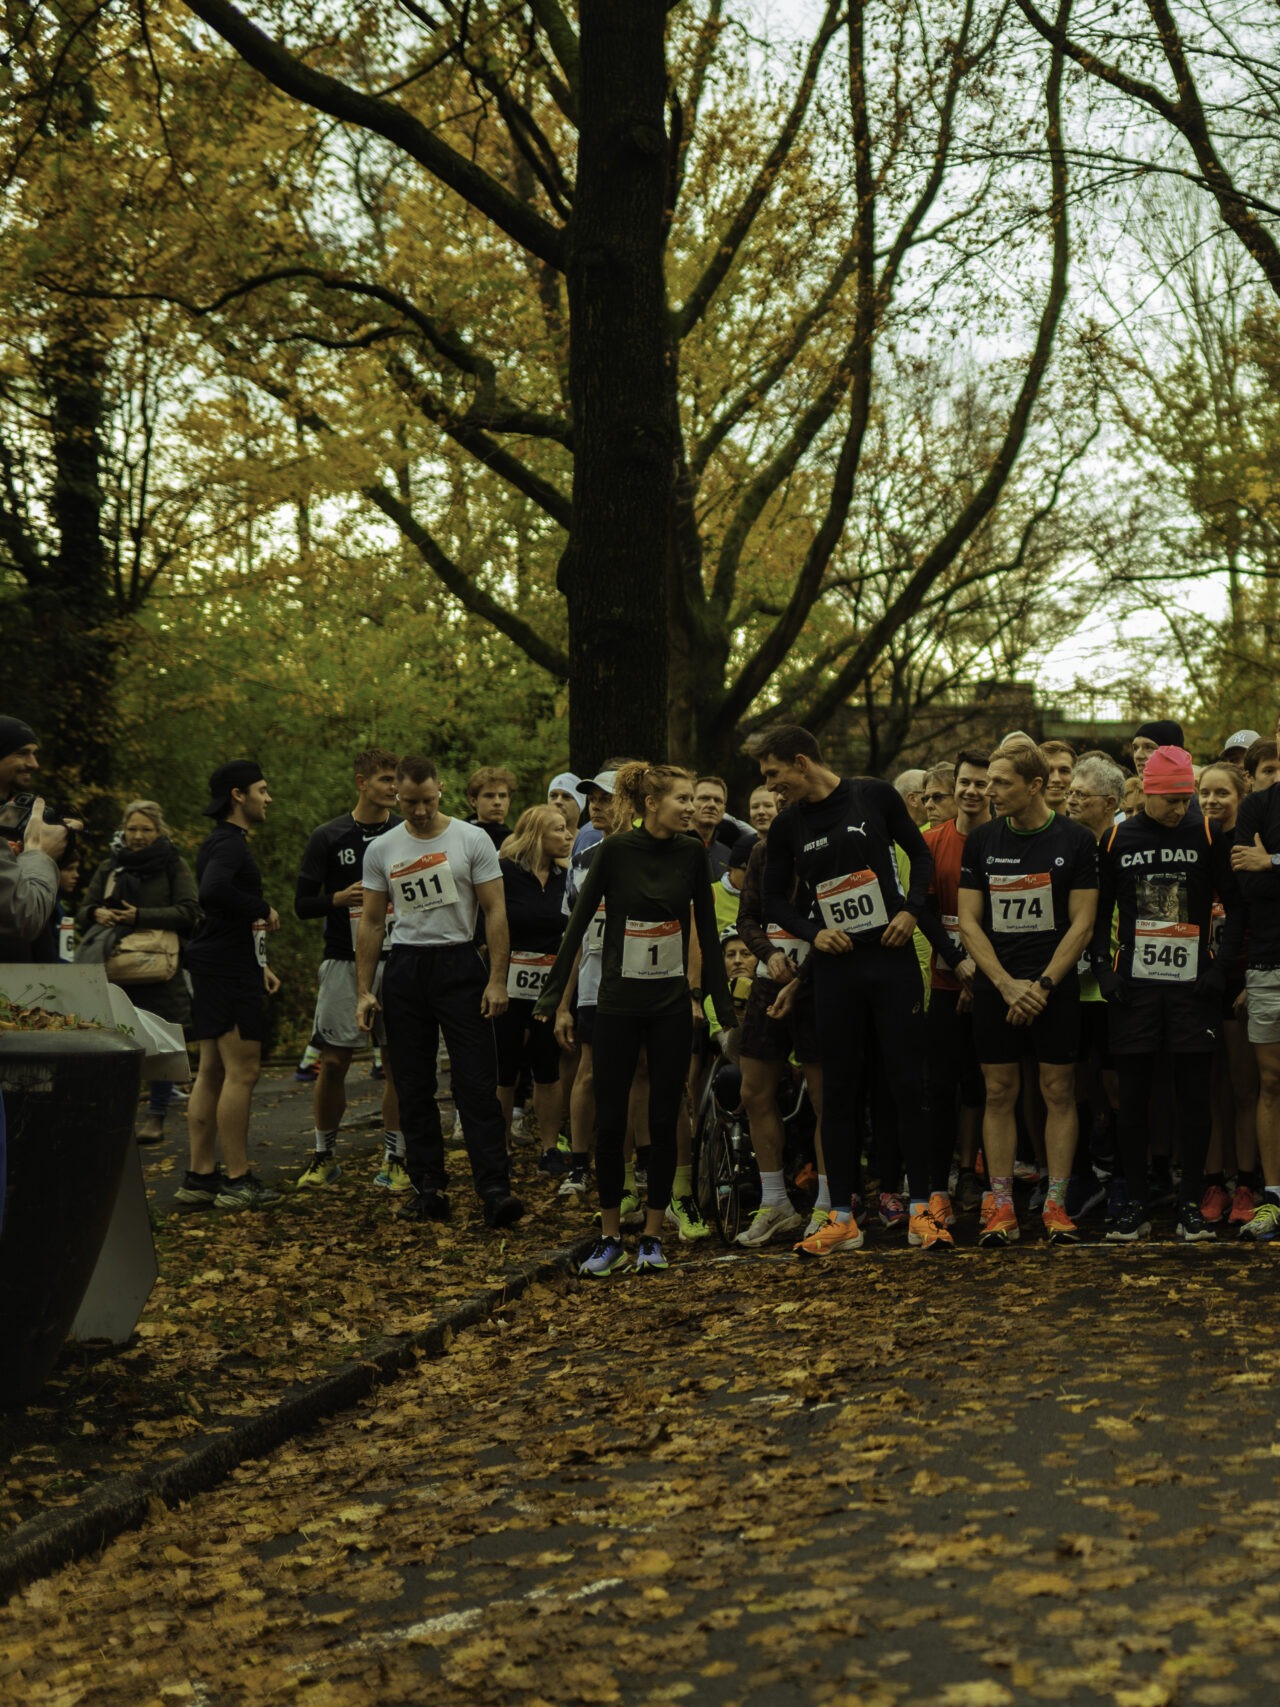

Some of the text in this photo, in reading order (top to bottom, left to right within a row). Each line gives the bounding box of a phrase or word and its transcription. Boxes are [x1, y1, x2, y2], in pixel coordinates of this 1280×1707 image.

[337, 848, 357, 865] 18
[1120, 848, 1198, 868] CAT DAD
[400, 873, 443, 902] 511
[829, 894, 874, 924] 560
[999, 897, 1042, 919] 774
[647, 944, 658, 966] 1
[1143, 944, 1188, 968] 546
[516, 970, 551, 990] 629
